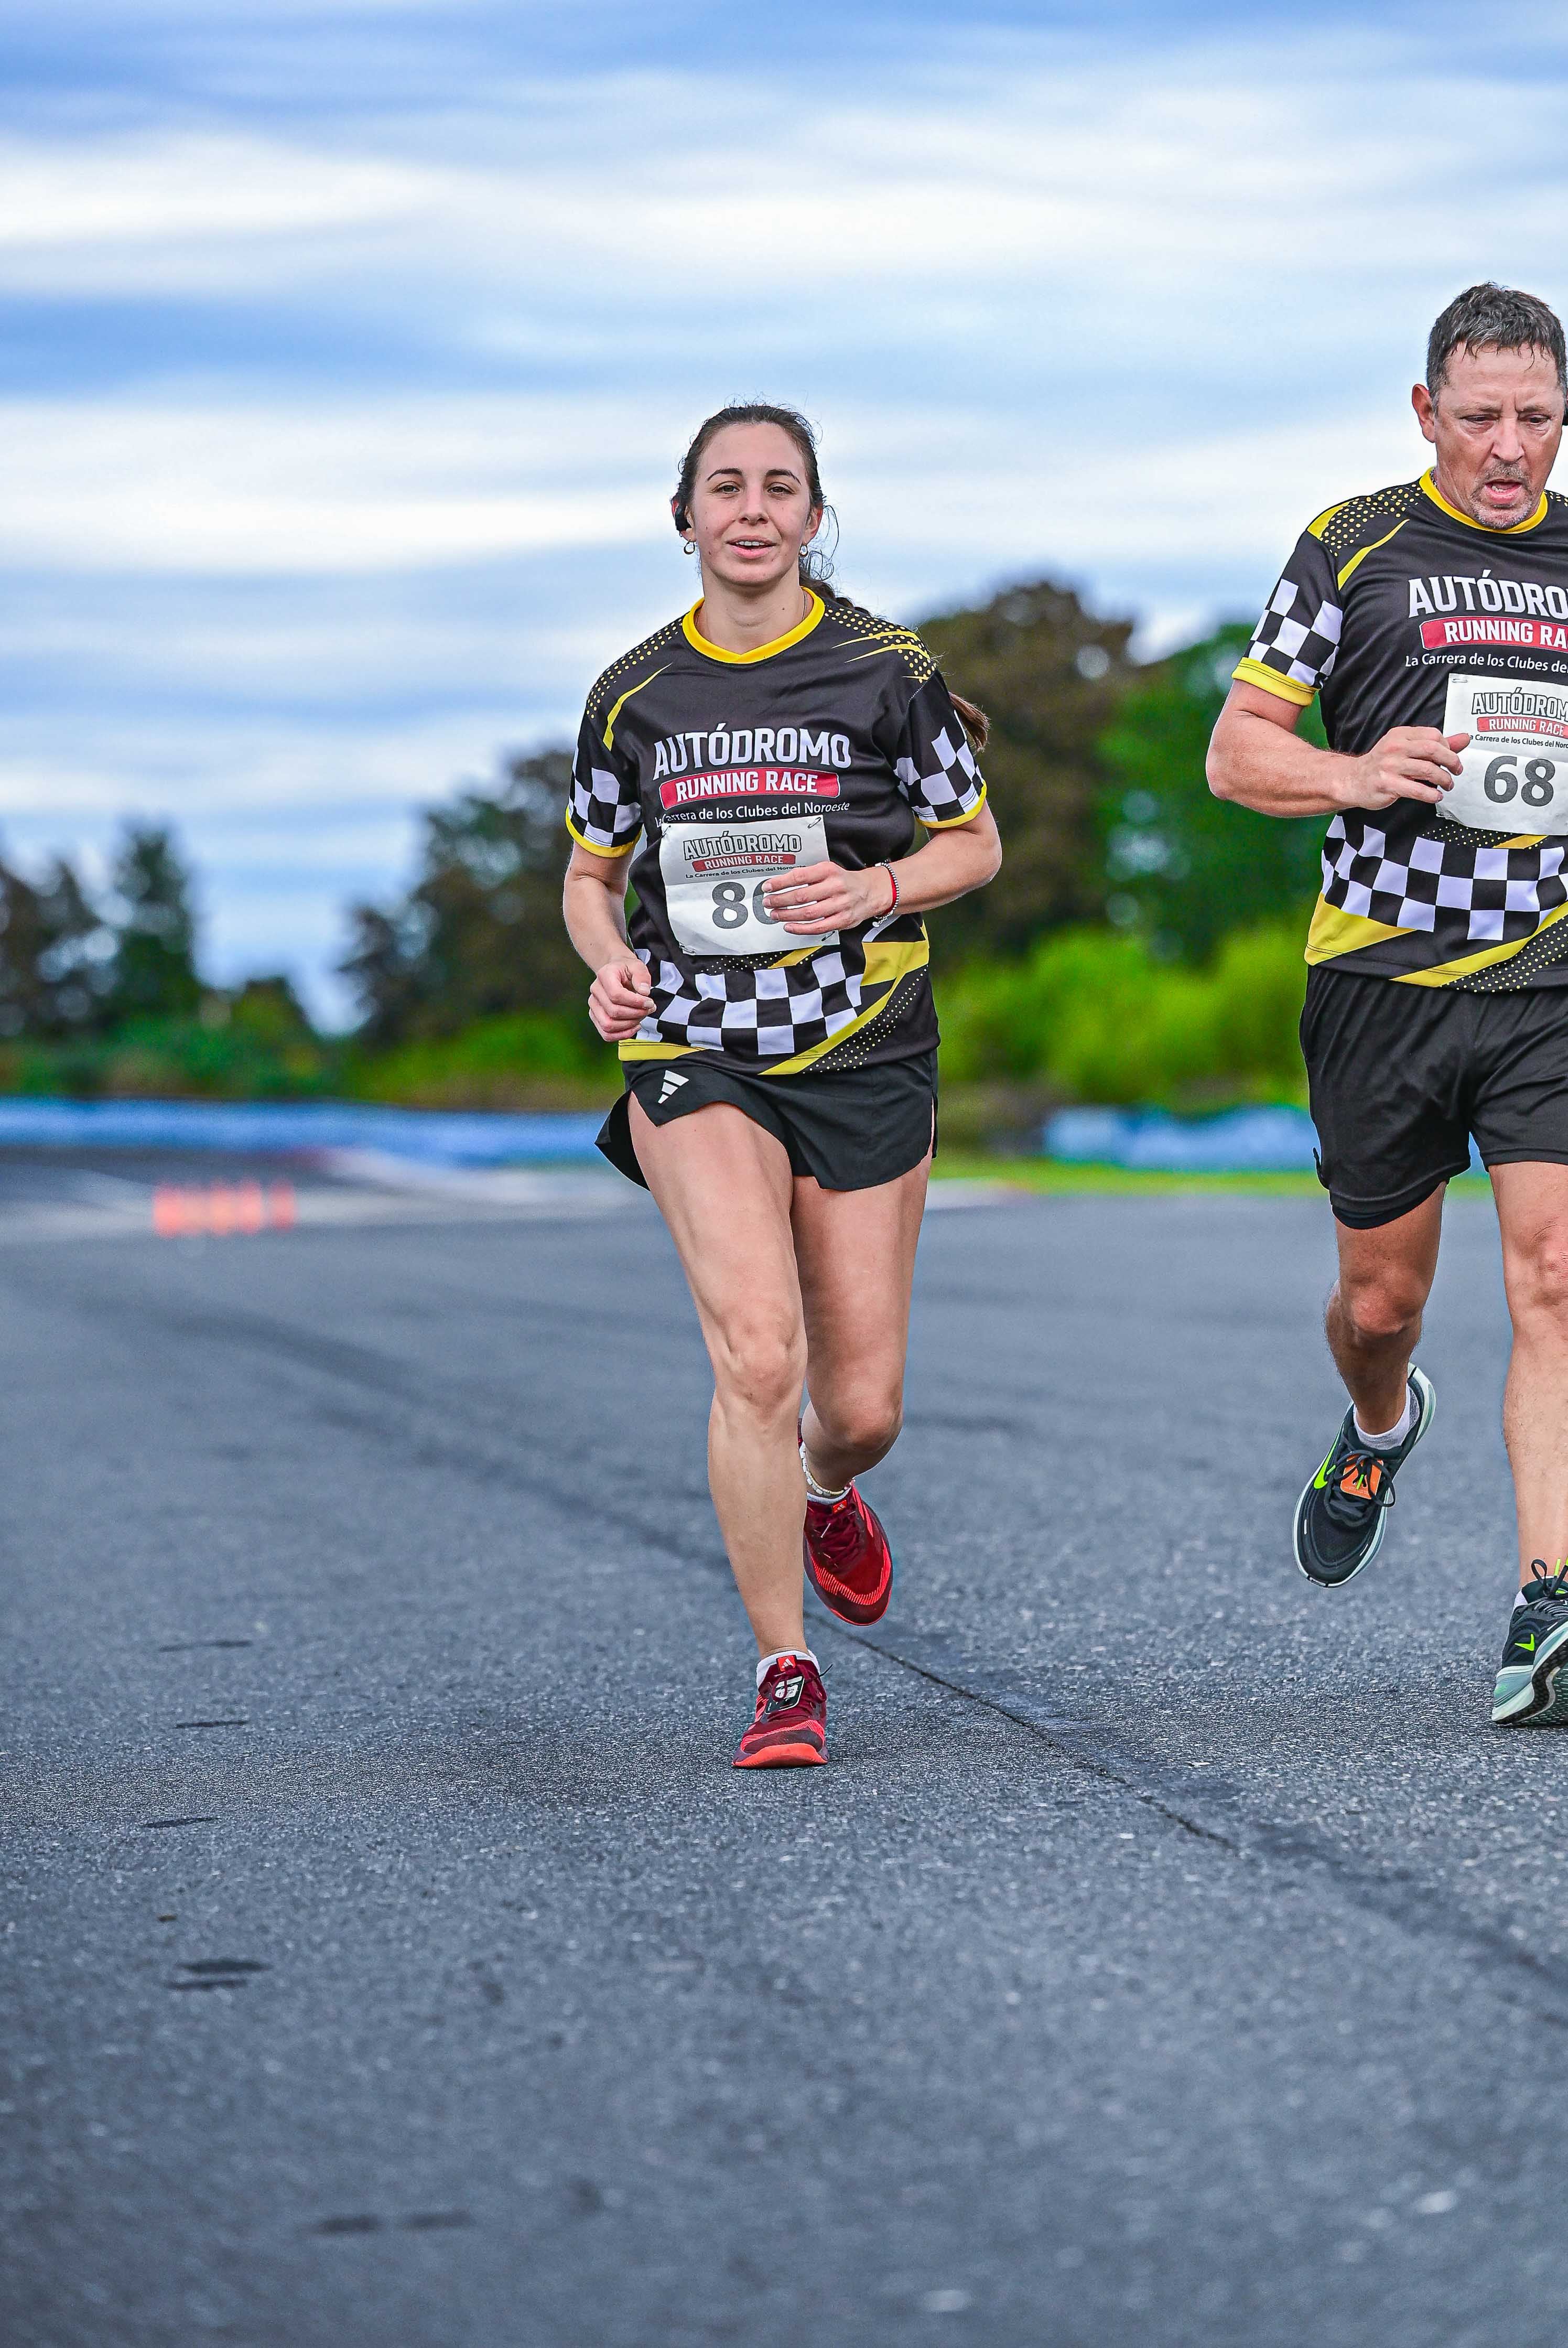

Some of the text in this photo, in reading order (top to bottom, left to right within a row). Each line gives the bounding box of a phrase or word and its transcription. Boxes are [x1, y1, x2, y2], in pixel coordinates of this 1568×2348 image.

[1408, 569, 1568, 620] AUTÓDRO
[1443, 620, 1568, 650] RUNNING RA
[1405, 655, 1419, 667] La
[1422, 654, 1466, 665] Carrera
[1469, 653, 1484, 665] de
[1487, 653, 1504, 666] los
[1507, 656, 1548, 671] Clubes
[1489, 718, 1564, 737] RUNNING RACE
[653, 723, 851, 780] AUTÓDROMO
[675, 771, 818, 803] RUNNING RACE
[1484, 756, 1555, 806] 68
[662, 813, 697, 823] Carrera
[699, 808, 713, 820] de
[717, 807, 733, 819] los
[736, 805, 777, 817] Clubes
[781, 802, 801, 815] del
[805, 802, 850, 814] Noroeste
[683, 831, 802, 860] AUTÓDROMO
[704, 855, 783, 869] RUNNING RACE
